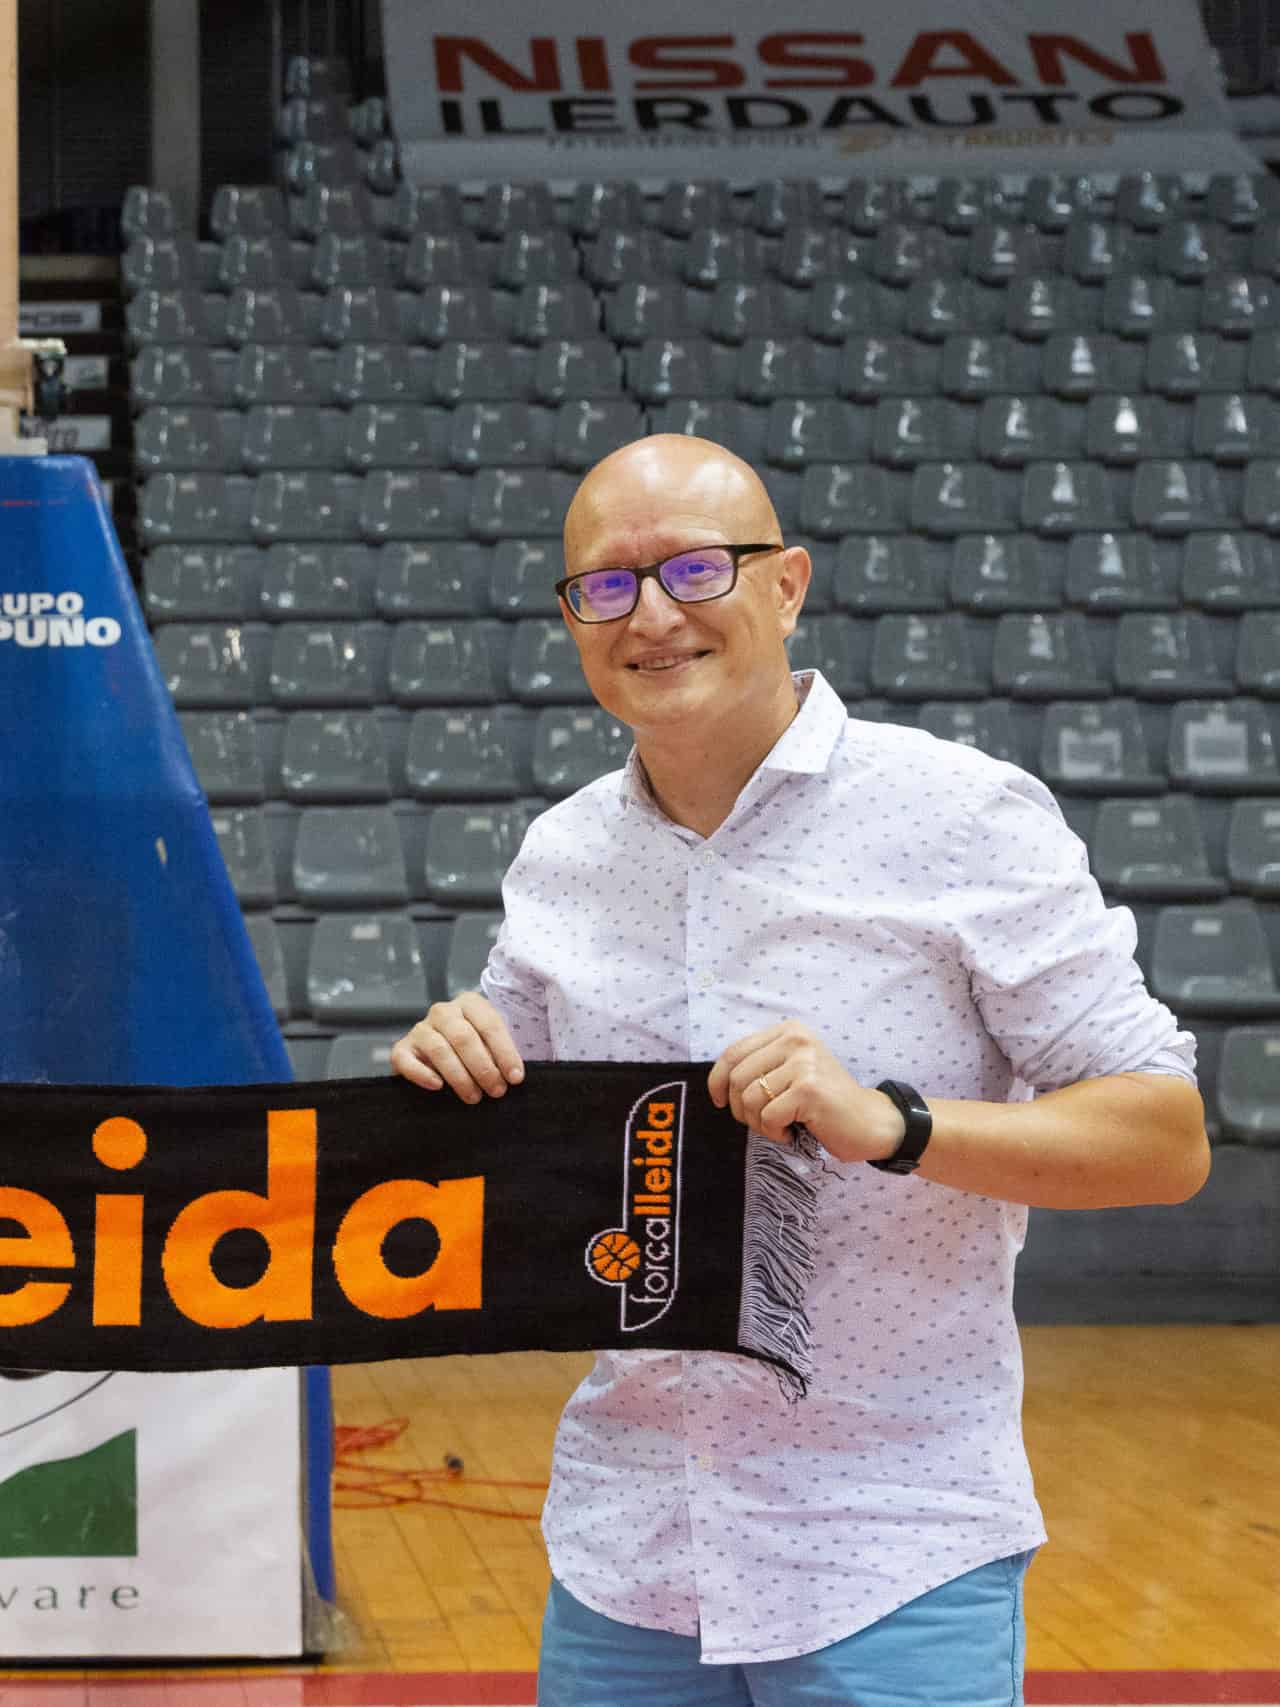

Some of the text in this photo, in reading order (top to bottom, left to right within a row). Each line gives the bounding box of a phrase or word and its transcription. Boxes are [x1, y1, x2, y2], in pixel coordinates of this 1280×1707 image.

[432, 31, 1170, 92] NISSAN
[439, 91, 1184, 136] ILERDAUTO
[629, 1103, 675, 1303] força lleida
